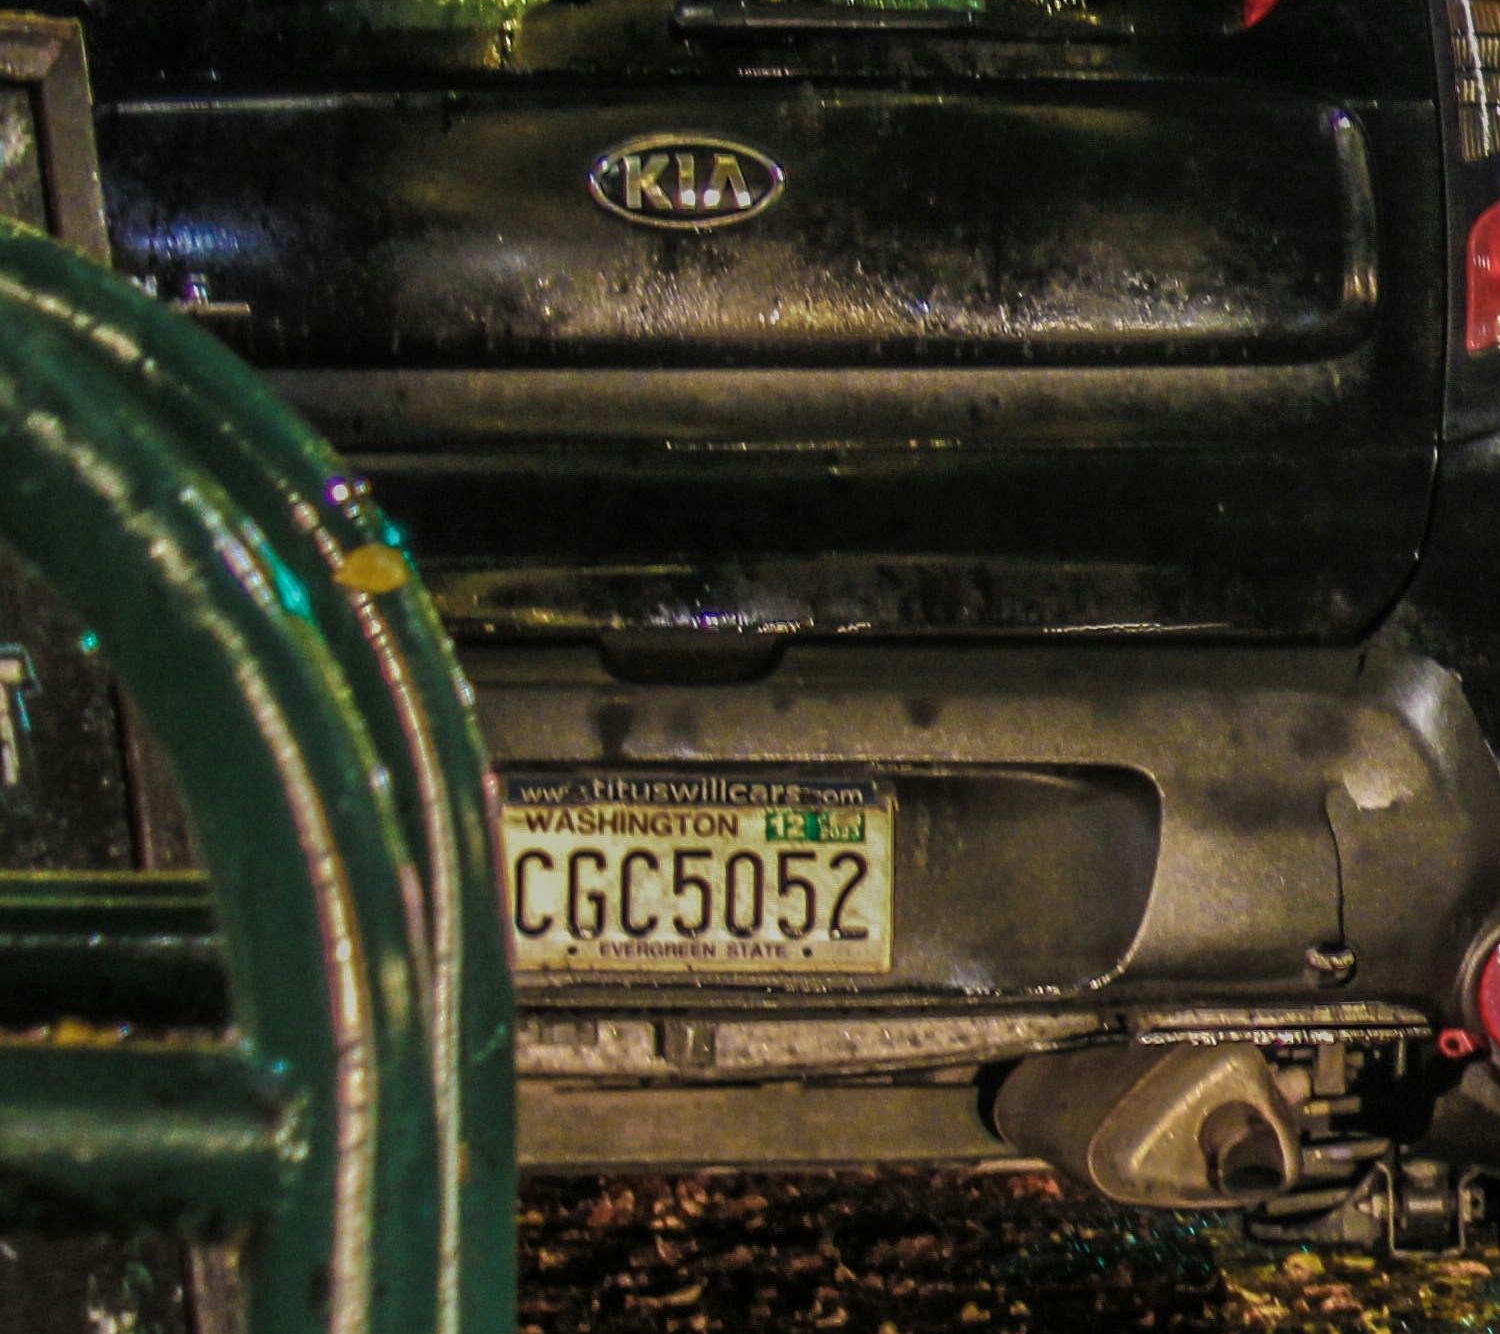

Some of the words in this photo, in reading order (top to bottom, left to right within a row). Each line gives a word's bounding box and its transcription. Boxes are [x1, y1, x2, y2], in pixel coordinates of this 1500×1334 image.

[622, 153, 752, 209] KIA
[524, 809, 739, 838] WASHINGTON
[515, 847, 869, 940] CGC5052
[600, 941, 716, 958] EVERGREEN
[727, 942, 788, 958] STATE
